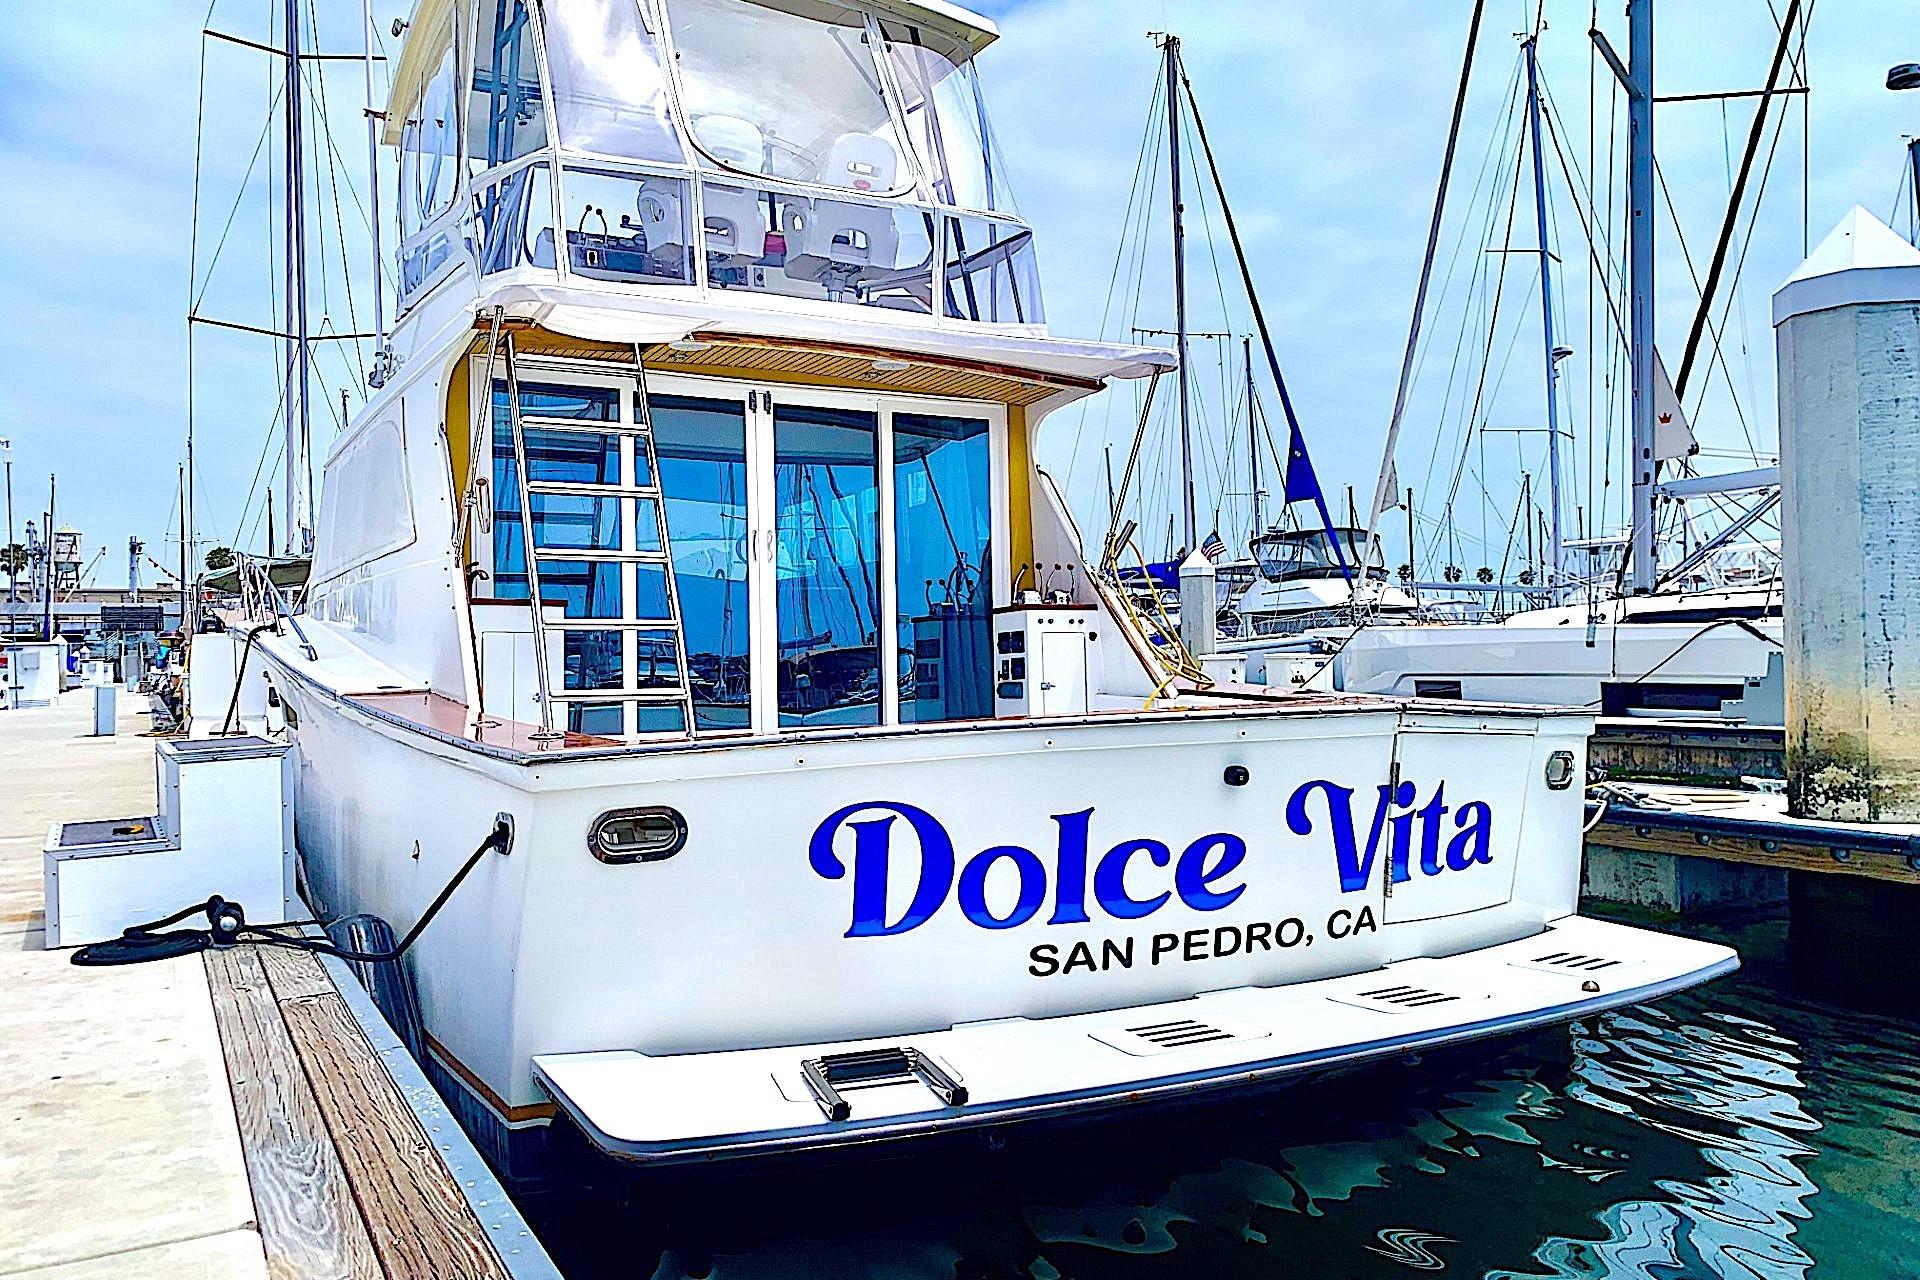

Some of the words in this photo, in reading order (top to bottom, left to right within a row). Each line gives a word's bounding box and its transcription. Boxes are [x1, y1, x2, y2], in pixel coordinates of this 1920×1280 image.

[809, 802, 1247, 938] Dolce
[1286, 779, 1493, 893] Vita
[1028, 936, 1134, 977] SAN
[1151, 917, 1314, 966] PEDRO,
[1326, 905, 1377, 940] CA
